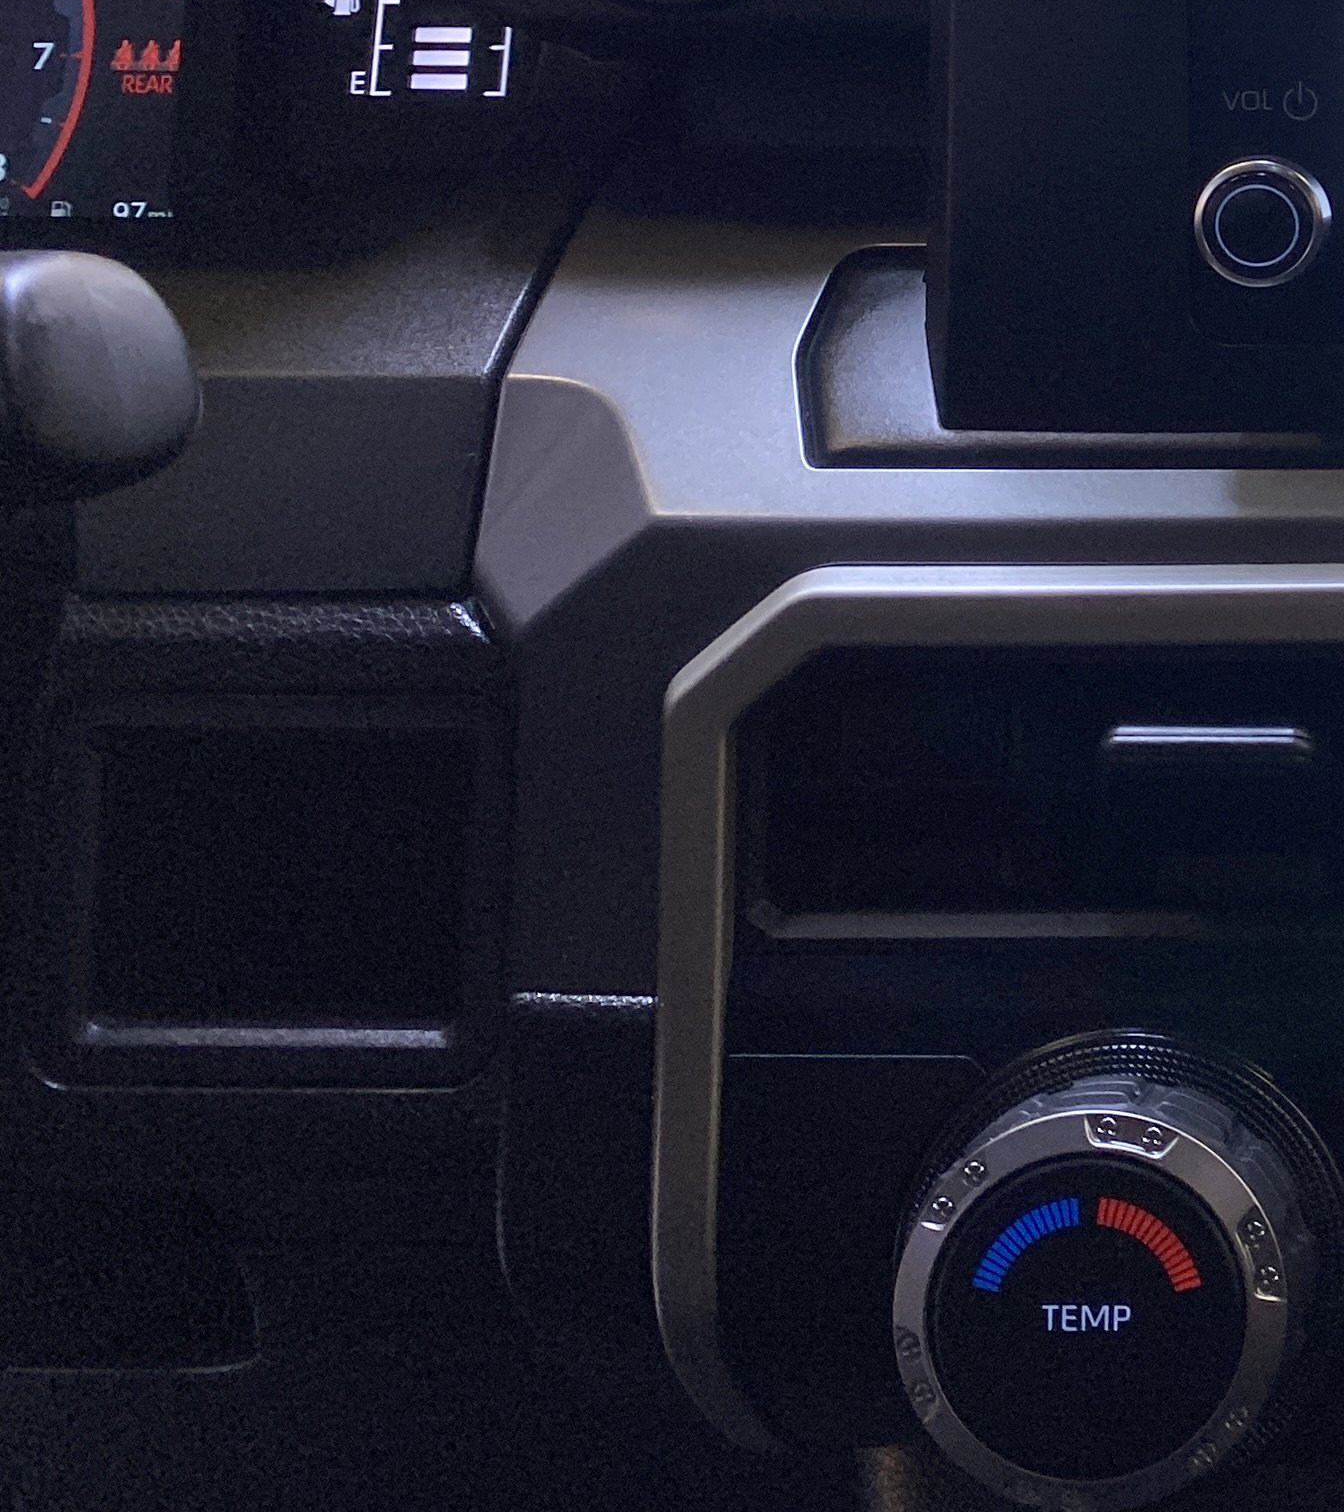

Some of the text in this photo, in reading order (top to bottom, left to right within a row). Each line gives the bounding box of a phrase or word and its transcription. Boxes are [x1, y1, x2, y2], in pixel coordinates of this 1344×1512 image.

[32, 42, 55, 70] 7
[121, 73, 174, 95] REAR
[349, 70, 367, 95] E
[1222, 89, 1273, 111] VOL
[1041, 1303, 1132, 1332] TEMP
